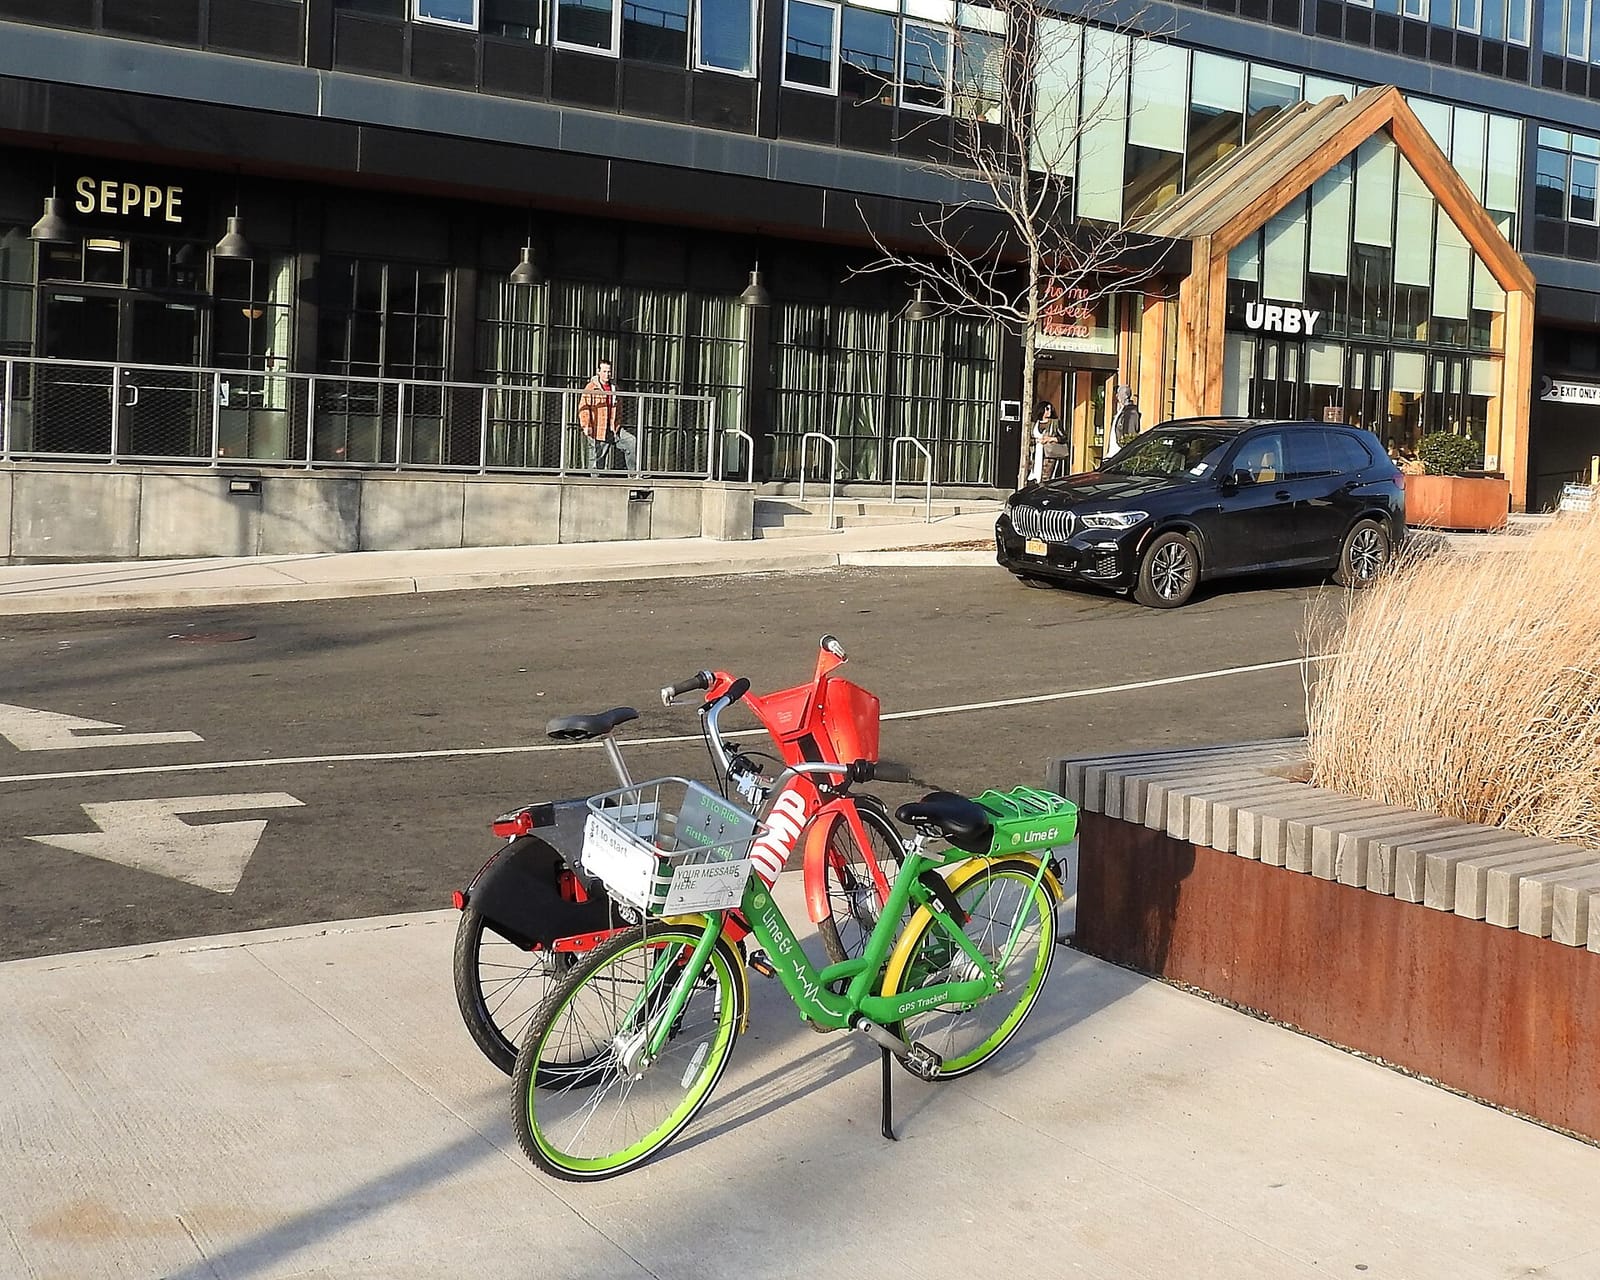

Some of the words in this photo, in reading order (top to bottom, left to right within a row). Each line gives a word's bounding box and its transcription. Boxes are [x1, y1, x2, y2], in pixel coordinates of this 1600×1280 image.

[75, 176, 183, 222] SEPPE
[1044, 277, 1089, 299] home
[1044, 301, 1092, 319] sweet
[1245, 302, 1320, 336] URBY
[1043, 315, 1090, 338] home
[1560, 386, 1577, 398] EXIT
[1579, 387, 1597, 399] ONLY
[711, 800, 720, 813] to
[720, 806, 740, 826] Ride
[600, 829, 609, 842] to
[609, 838, 628, 857] start
[685, 825, 701, 841] First
[701, 834, 715, 849] Rid
[748, 789, 806, 883] UMP
[673, 880, 696, 890] HERE
[677, 868, 700, 880] YOUR
[898, 1001, 916, 1014] GPS
[917, 990, 948, 1008] Tracked
